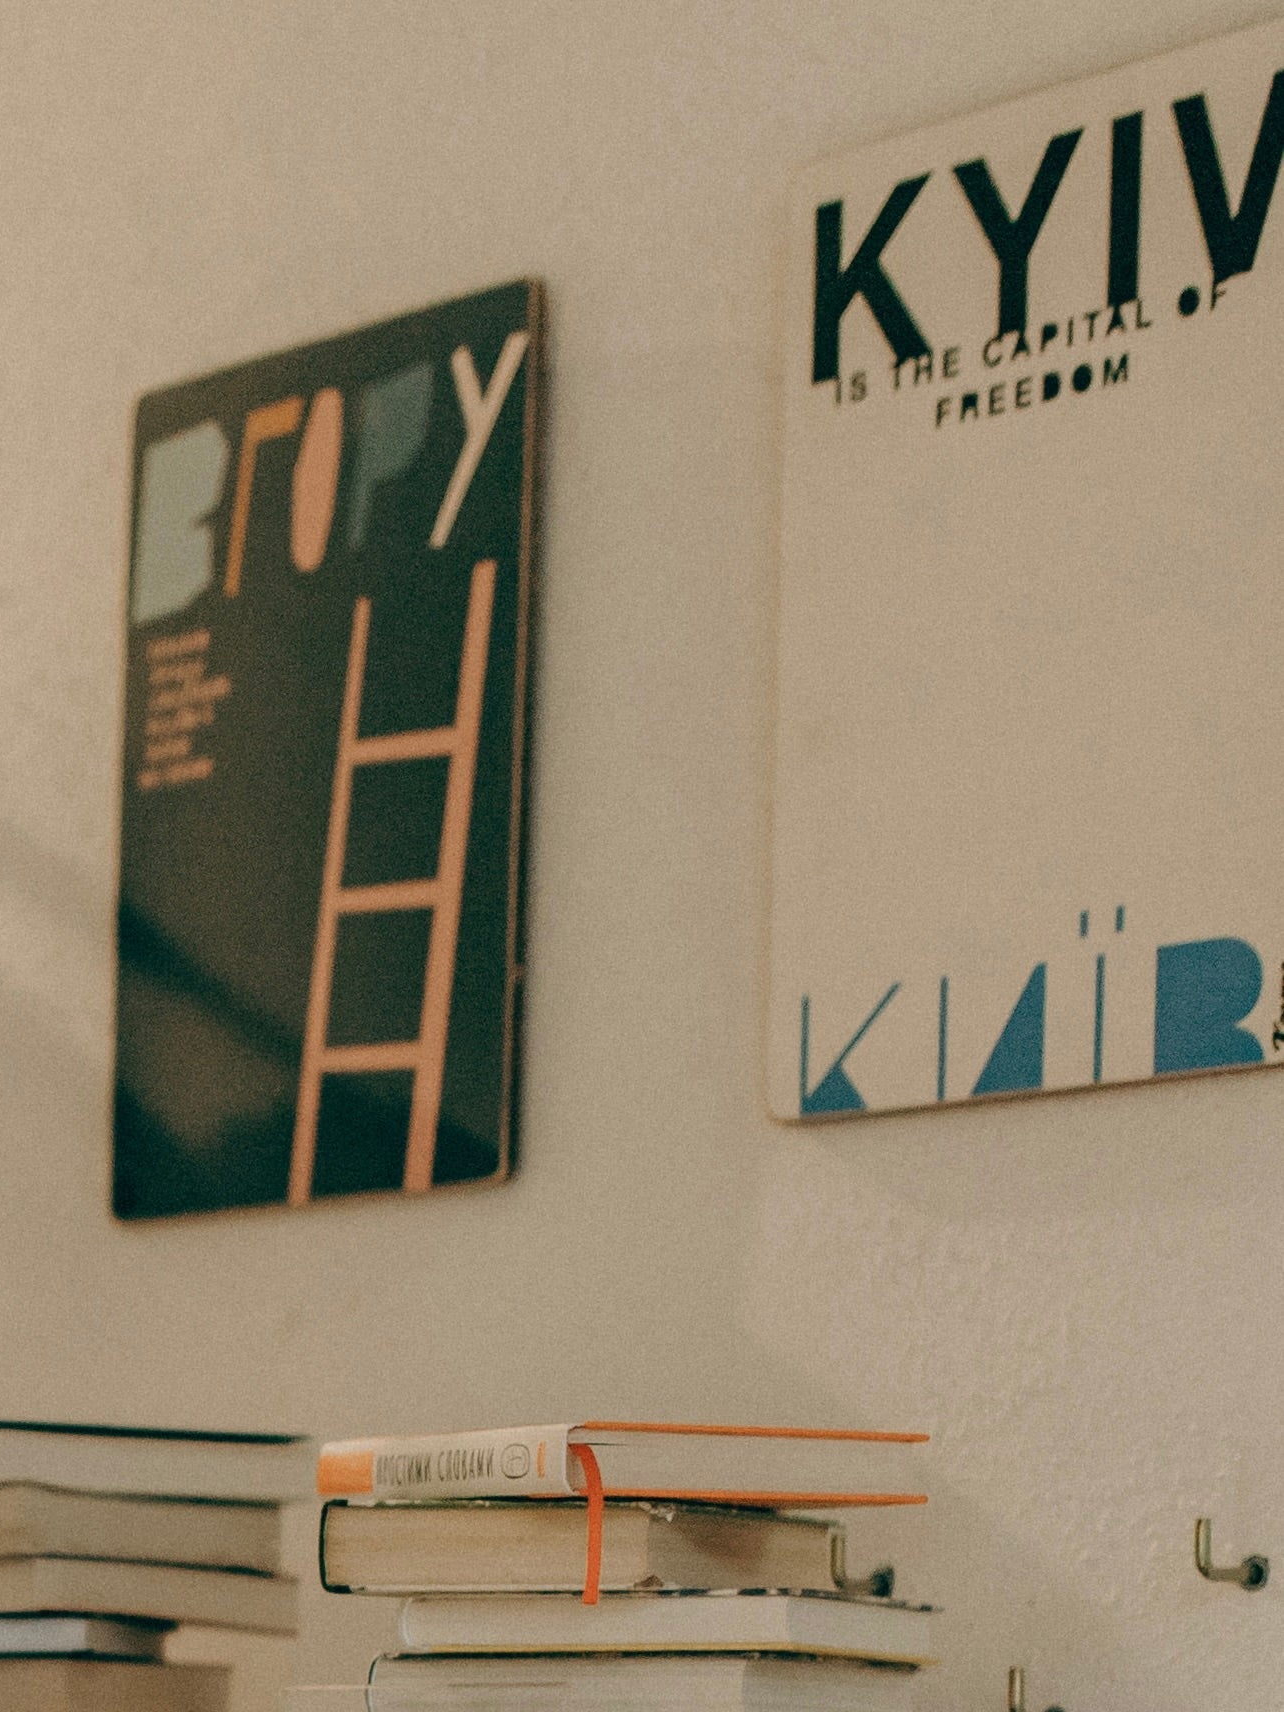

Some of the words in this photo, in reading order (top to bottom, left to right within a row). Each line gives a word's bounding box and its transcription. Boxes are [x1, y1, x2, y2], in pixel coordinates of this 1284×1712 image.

[812, 68, 1284, 385] KYIV
[835, 371, 867, 407] IS
[890, 347, 961, 391] THE
[983, 300, 1152, 367] CAPITAL
[1178, 285, 1227, 318] OF
[935, 353, 1130, 428] FREEDOM
